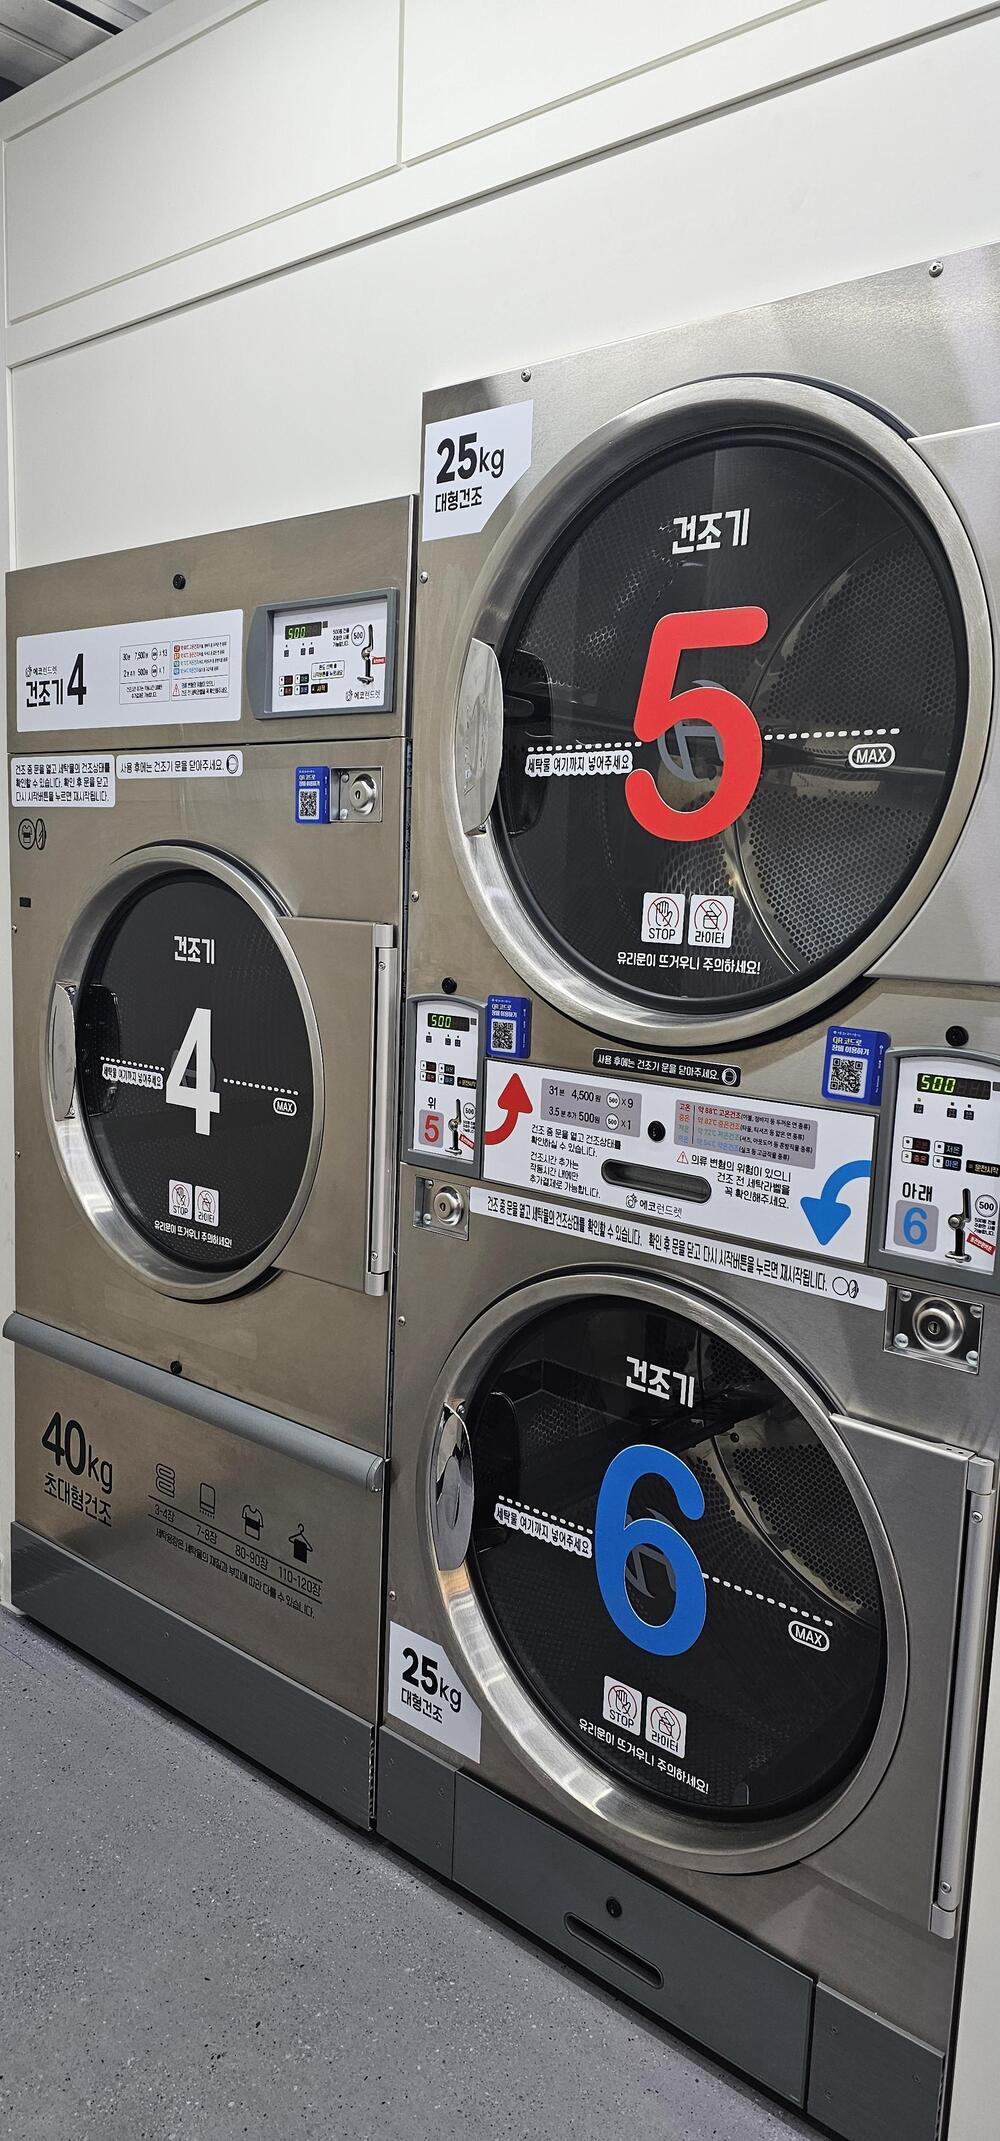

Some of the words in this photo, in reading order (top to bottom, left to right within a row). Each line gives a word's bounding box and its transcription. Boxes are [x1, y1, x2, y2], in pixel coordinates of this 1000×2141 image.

[437, 432, 504, 484] 25kg
[435, 486, 482, 512] 대형건조
[672, 508, 750, 554] 건조기
[288, 627, 305, 639] 500
[353, 631, 363, 640] 500
[26, 679, 63, 707] 건조기
[67, 653, 86, 705] 4
[354, 690, 380, 699] 에코런드렛
[625, 606, 768, 842] 5
[121, 762, 132, 773] 사용
[134, 762, 152, 773] 후에는
[154, 761, 173, 772] 건조기
[175, 761, 187, 772] 문을
[190, 759, 224, 771] 닫아주세요.
[528, 758, 550, 773] 세탁물
[554, 757, 585, 771] 여기까지
[589, 755, 629, 771] 넣어주세요
[857, 747, 887, 765] MAX
[16, 764, 25, 775] 건조
[27, 765, 32, 775] 중
[34, 765, 44, 774] 문을
[46, 764, 56, 774] 열고
[58, 763, 80, 774] 세탁물의
[82, 763, 110, 773] 건조상태를
[16, 778, 31, 788] 확인할
[33, 779, 38, 787] 수
[39, 778, 62, 788] 있습니다.
[64, 777, 75, 787] 확인
[77, 777, 82, 787] 후
[84, 777, 94, 787] 문을
[97, 777, 108, 787] 닫고
[16, 792, 26, 801] 다시
[28, 791, 53, 801] 시작버튼을
[56, 791, 71, 801] 누르면
[73, 791, 109, 801] 재시작됩니다.
[649, 928, 676, 940] STOP
[695, 931, 724, 944] 라이터
[174, 935, 214, 965] 건조기
[617, 952, 656, 967] 유리문이
[659, 955, 700, 970] 뜨거우니
[703, 958, 761, 975] 주의하세요!
[432, 1014, 451, 1028] 500
[166, 1007, 220, 1136] 4
[598, 1054, 611, 1065] 사용
[614, 1057, 635, 1068] 후에는
[637, 1060, 659, 1072] 건조기
[662, 1062, 676, 1074] 문을
[679, 1065, 719, 1080] 닫아주세요.
[921, 1075, 955, 1093] 500
[276, 1102, 293, 1112] MAX
[428, 1097, 436, 1109] 위
[425, 1115, 439, 1142] 5
[532, 1124, 545, 1135] 건조
[546, 1127, 553, 1136] 중
[555, 1128, 568, 1140] 문을
[570, 1132, 584, 1143] 열고
[586, 1134, 621, 1150] 건조상태를
[531, 1135, 557, 1149] 확인하실
[560, 1141, 566, 1150] 수
[568, 1144, 598, 1158] 있습니다.
[530, 1152, 557, 1165] 건조시간
[559, 1158, 579, 1170] 추가는
[530, 1163, 556, 1177] 작동시간
[558, 1170, 578, 1182] 내에만
[691, 1154, 707, 1166] 의류
[710, 1157, 734, 1172] 변형의
[737, 1163, 762, 1177] 위험이
[765, 1168, 791, 1183] 있으니
[530, 1174, 563, 1190] 추가결제로
[564, 1183, 600, 1198] 가능합니다.
[717, 1172, 733, 1184] 건조
[736, 1175, 745, 1187] 전
[746, 1177, 790, 1196] 세탁라벨을
[902, 1182, 933, 1202] 아래
[640, 1199, 682, 1218] 에코런드렛
[725, 1186, 733, 1197] 꼭
[736, 1188, 789, 1209] 확인해주세요.
[979, 1202, 994, 1211] 500
[173, 1206, 188, 1215] STOP
[155, 1220, 176, 1234] 유리문이
[178, 1225, 200, 1240] 뜨거우니
[903, 1207, 928, 1245] 6
[488, 1195, 498, 1212] 건조
[500, 1199, 506, 1214] 중
[507, 1200, 518, 1216] 문을
[519, 1203, 531, 1220] 열고
[532, 1206, 555, 1225] 세탁물의
[556, 1211, 585, 1233] 건조상태를
[587, 1218, 606, 1238] 확인할
[607, 1224, 614, 1238] 수
[616, 1226, 642, 1247] 있습니다.
[649, 1232, 662, 1251] 확인
[664, 1236, 671, 1252] 후
[672, 1238, 685, 1256] 문을
[687, 1241, 701, 1260] 닫고
[703, 1245, 717, 1264] 다시
[718, 1249, 754, 1274] 시작버튼을
[756, 1257, 778, 1279] 누르면
[780, 1263, 827, 1291] 재시작됩니다.
[626, 1355, 695, 1408] 건조기
[42, 1412, 112, 1494] 40kg
[44, 1472, 112, 1527] 초대형건조
[497, 1508, 517, 1526] 세탁물
[520, 1516, 548, 1539] 여기까지
[552, 1528, 589, 1554] 넣어주세요
[154, 1503, 176, 1523] 3-4장
[196, 1524, 218, 1545] 7-8장
[235, 1544, 269, 1571] 80-90장
[279, 1566, 322, 1597] 110-120장
[595, 1444, 707, 1656] 6
[249, 1576, 262, 1591] 따라
[277, 1592, 284, 1602] 수
[286, 1595, 315, 1619] 있습니다.
[794, 1625, 823, 1647] MAX
[402, 1647, 462, 1713] 25kg
[401, 1688, 442, 1724] 대형건조
[610, 1709, 634, 1728] STOP
[651, 1730, 678, 1752] 라이터
[579, 1718, 614, 1746] 유리문이
[617, 1737, 654, 1766] 뜨거우니
[657, 1758, 709, 1795] 주의하세요!
